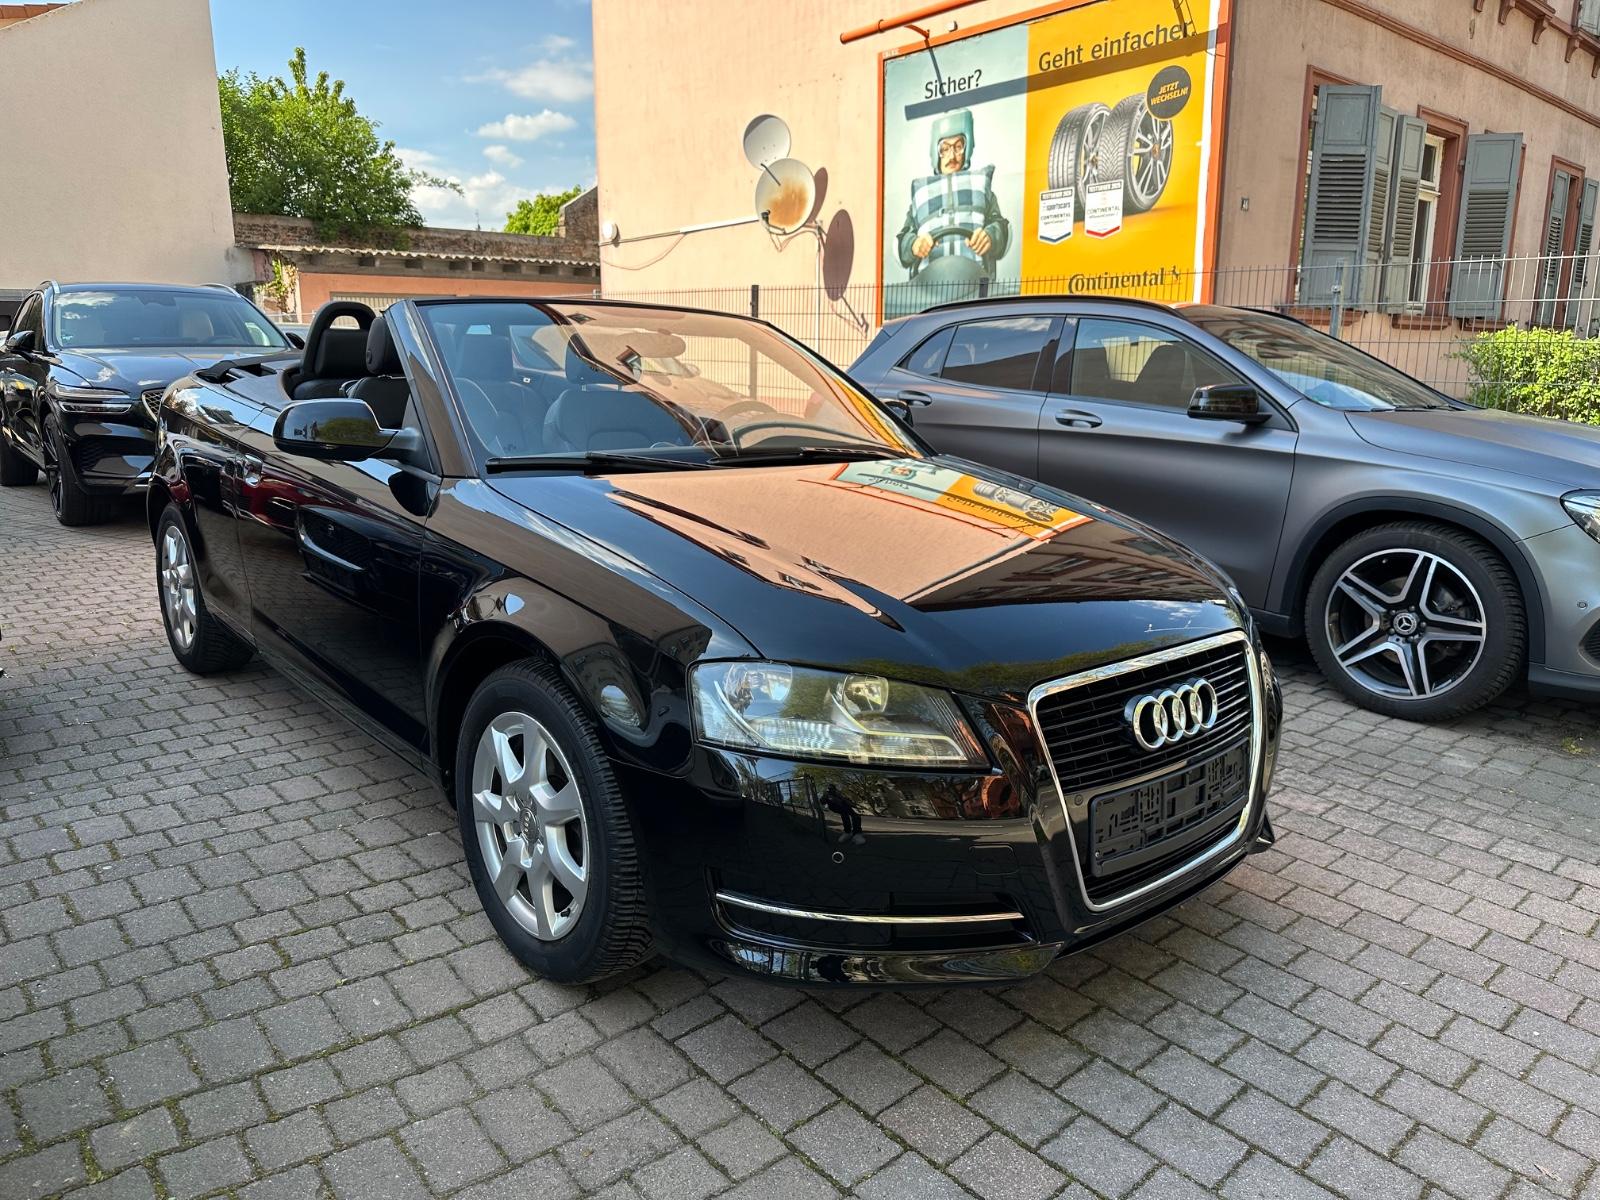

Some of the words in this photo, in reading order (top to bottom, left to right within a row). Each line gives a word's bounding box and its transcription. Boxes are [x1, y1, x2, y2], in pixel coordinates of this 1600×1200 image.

[1038, 44, 1084, 72] Geht
[924, 69, 982, 99] Sicher?
[1159, 81, 1180, 95] JETZT
[1068, 267, 1165, 294] Continental
